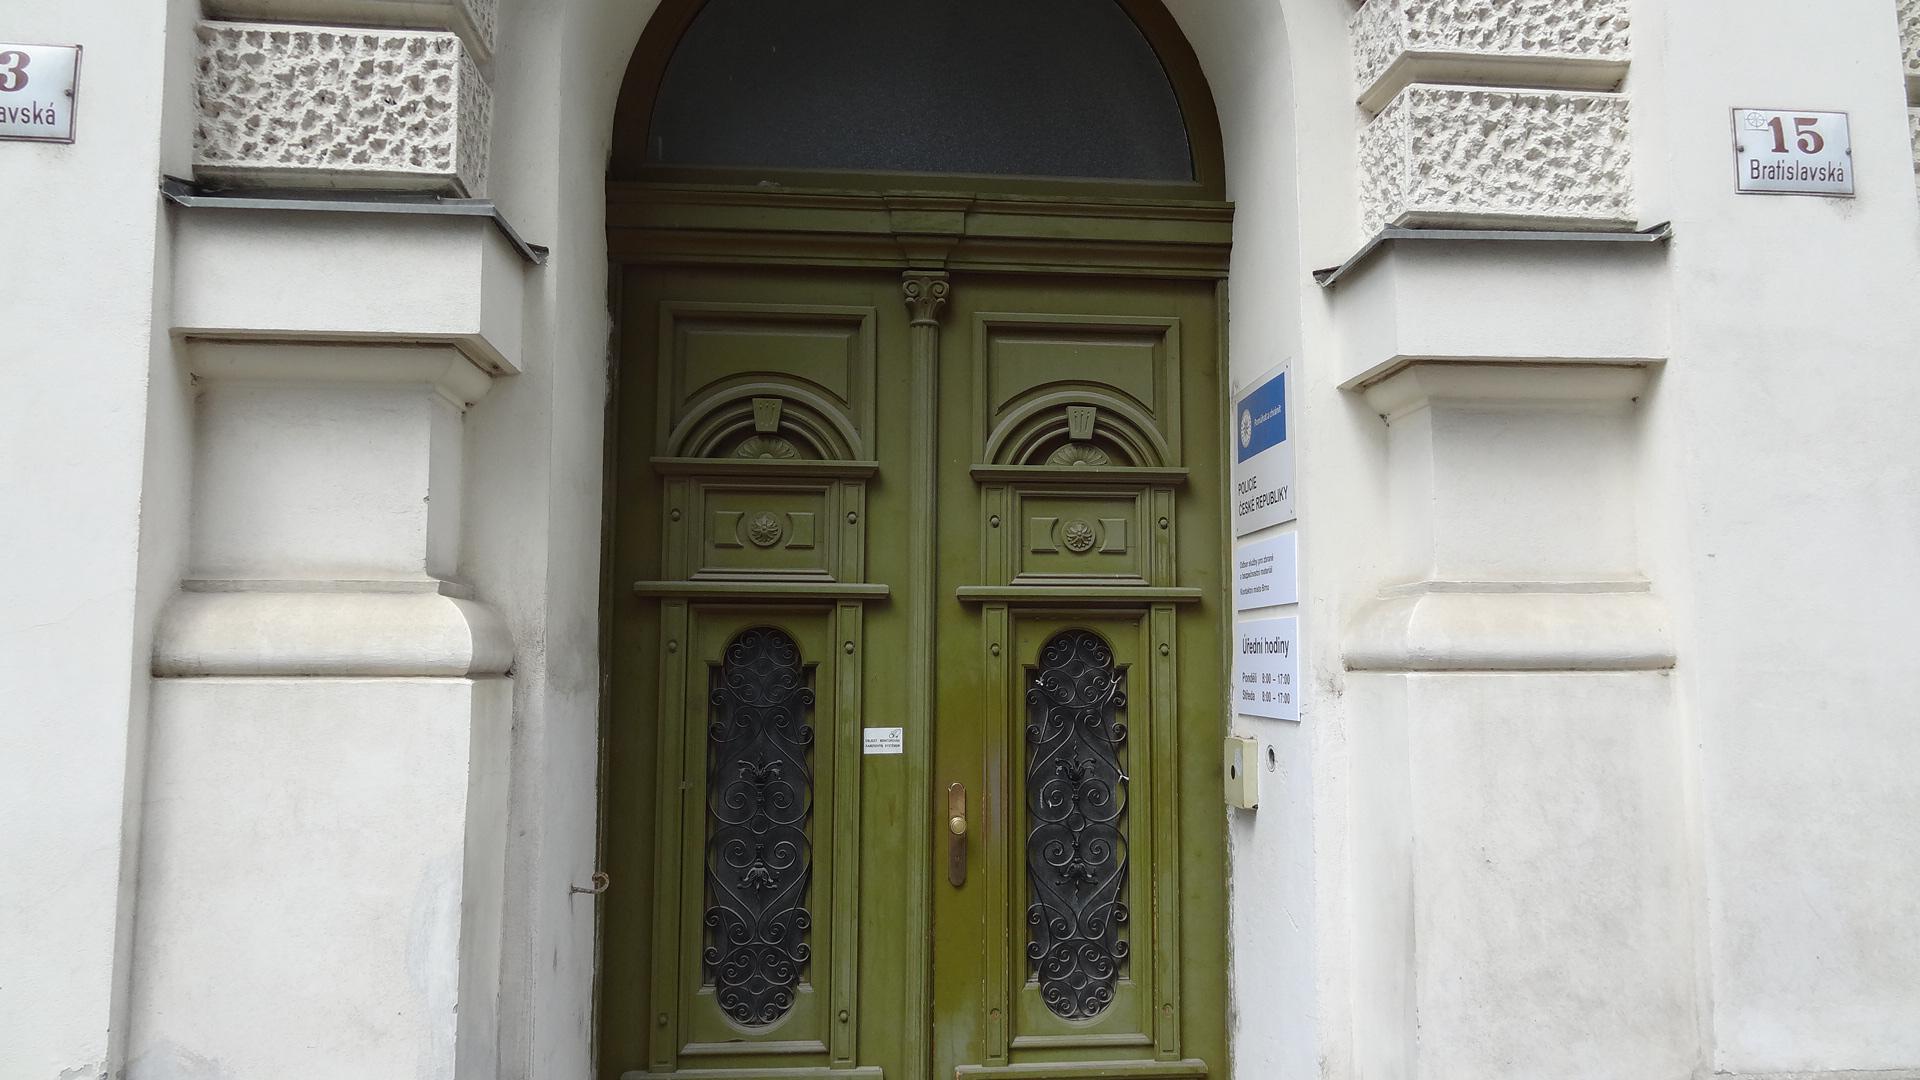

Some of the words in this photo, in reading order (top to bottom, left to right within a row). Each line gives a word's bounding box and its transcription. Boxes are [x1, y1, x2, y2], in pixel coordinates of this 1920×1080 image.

[1767, 116, 1824, 154] 15
[1750, 159, 1844, 182] Bratislavská
[1238, 475, 1257, 496] POLICIE
[1239, 496, 1255, 516] ČESKÉ
[1255, 485, 1288, 511] REPUBLIKY
[1242, 634, 1263, 654] Úřední
[1264, 636, 1289, 658] hodiny
[1277, 673, 1290, 685] 17:00
[1277, 692, 1290, 704] 17:00
